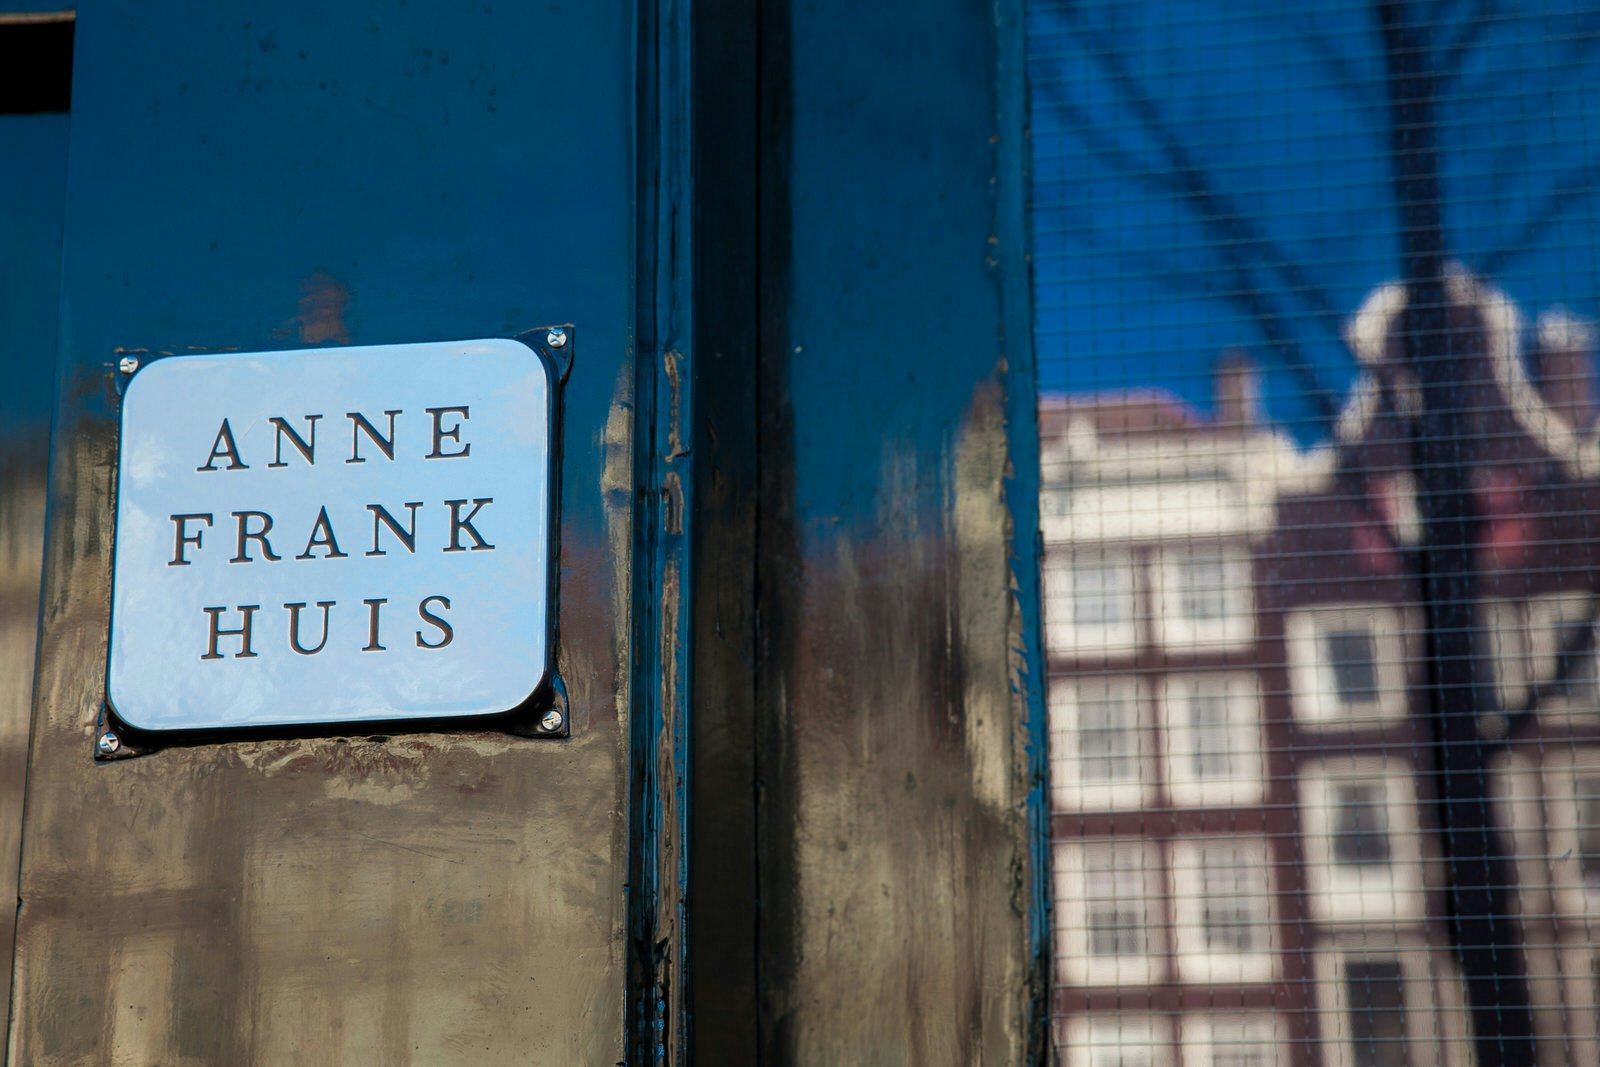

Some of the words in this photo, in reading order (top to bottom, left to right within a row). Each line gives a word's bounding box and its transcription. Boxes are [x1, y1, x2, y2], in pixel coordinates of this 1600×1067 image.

[196, 405, 471, 472] ANNE
[167, 497, 496, 566] FRANK
[200, 595, 454, 660] HUIS
